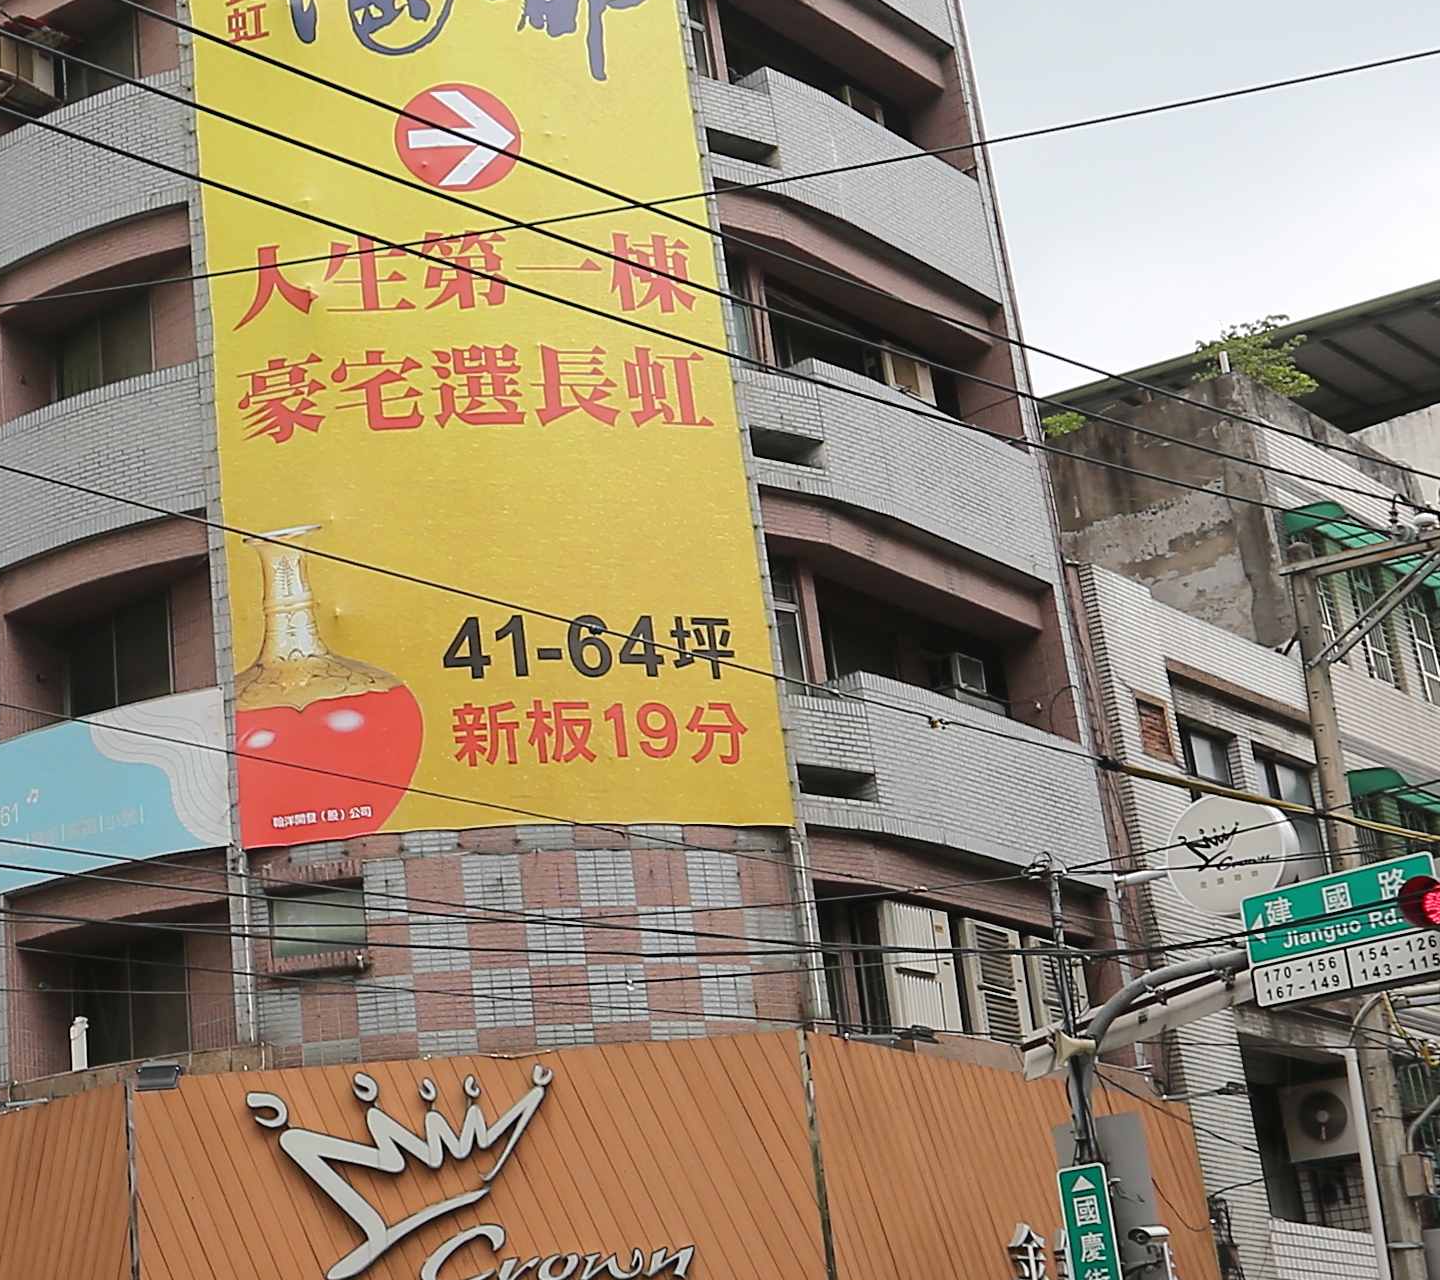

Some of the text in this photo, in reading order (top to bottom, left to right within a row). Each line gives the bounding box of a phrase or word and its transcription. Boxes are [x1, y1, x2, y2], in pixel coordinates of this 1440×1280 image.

[233, 229, 701, 333] 人生第一棟
[237, 345, 716, 445] 豪宅選長虹
[442, 613, 736, 682] 41-64坪
[451, 700, 749, 768] 新板19分
[1263, 867, 1408, 927] 建國路
[1282, 906, 1404, 949] Jianguo Rd.
[1263, 934, 1438, 983] 170-156 154-126
[1266, 974, 1340, 1001] 167-149
